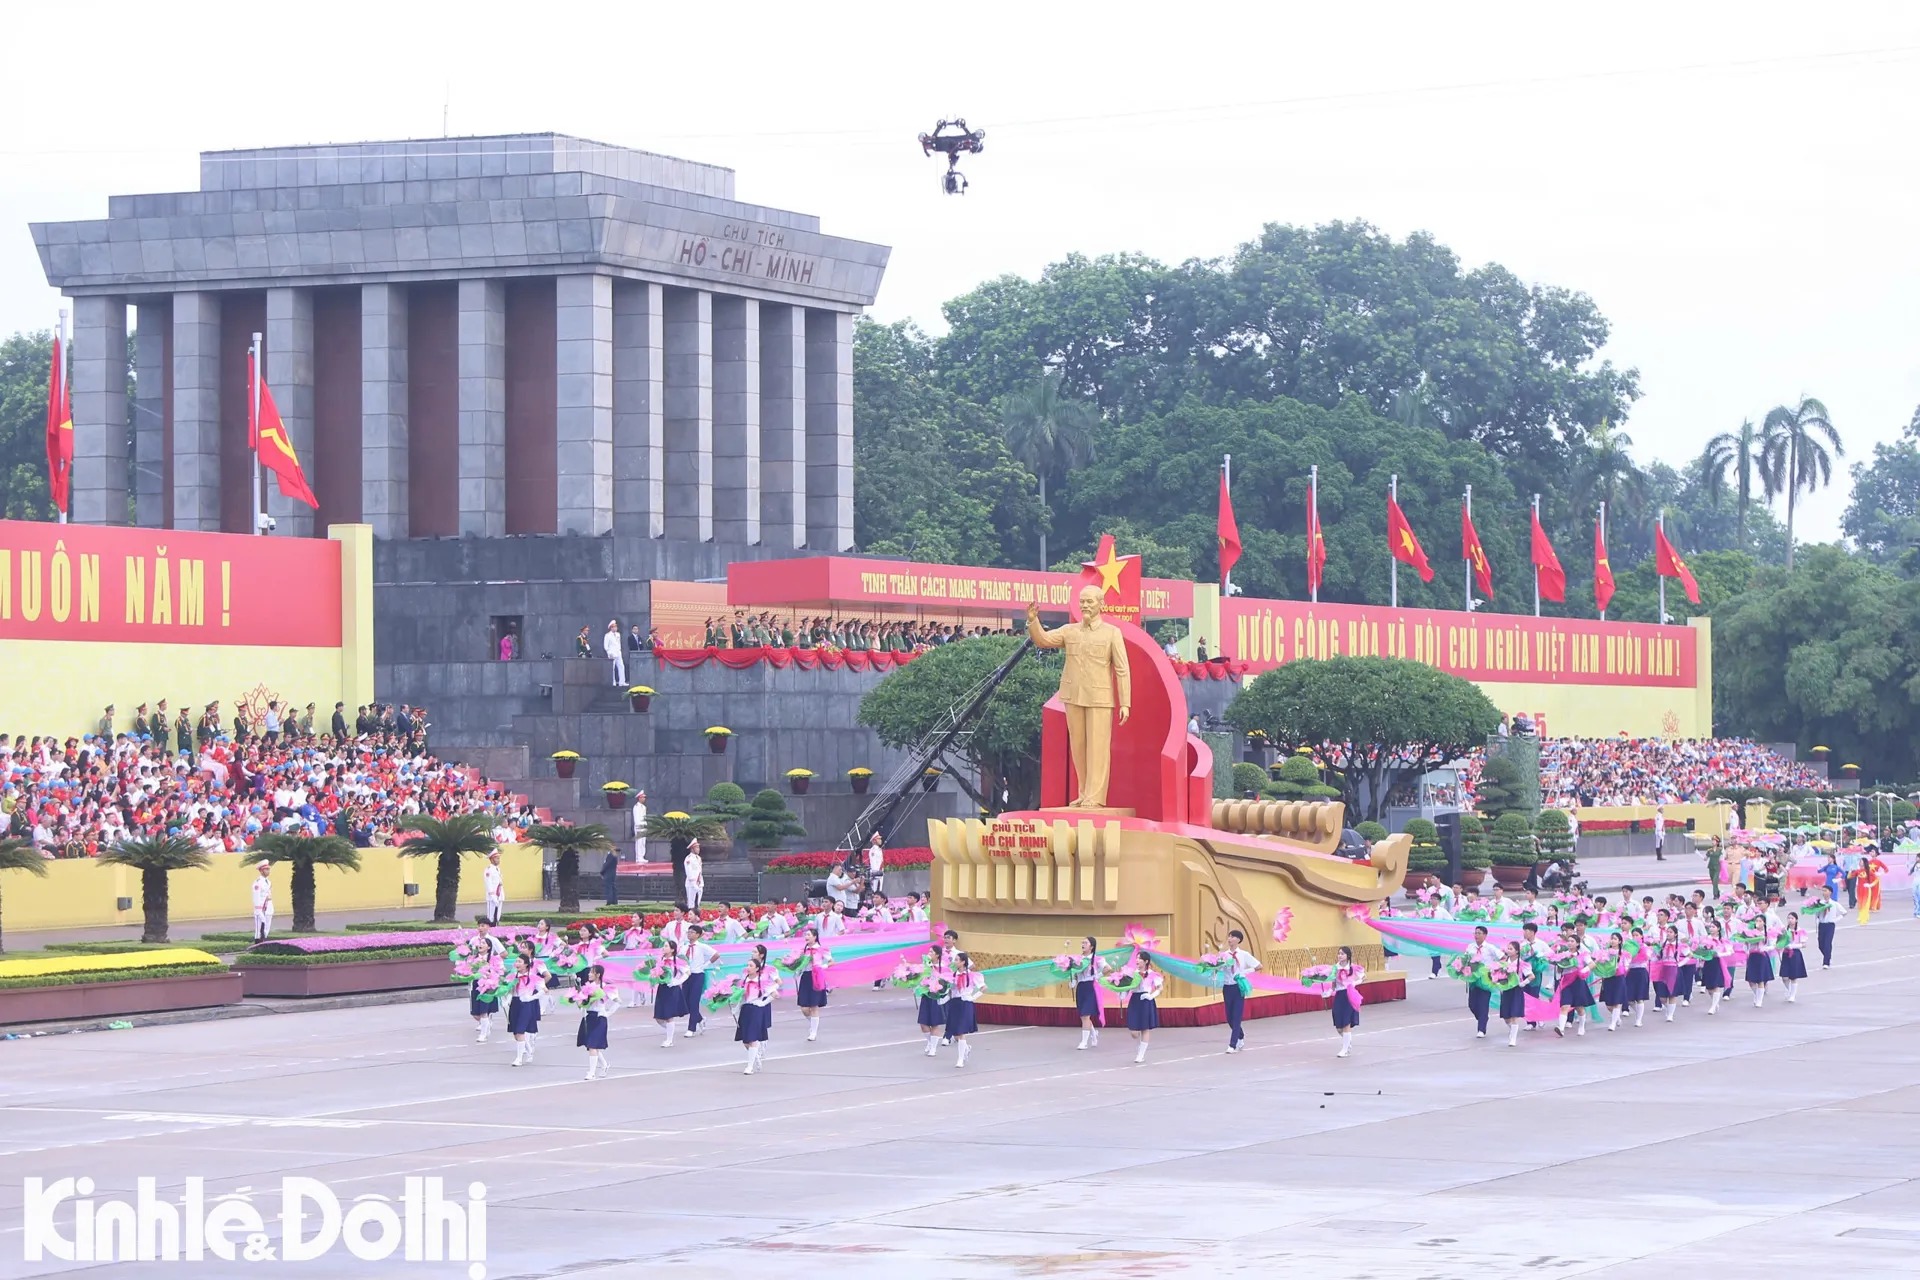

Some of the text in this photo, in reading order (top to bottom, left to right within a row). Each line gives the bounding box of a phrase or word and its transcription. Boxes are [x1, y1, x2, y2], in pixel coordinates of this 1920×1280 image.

[861, 572, 887, 594] TINH
[920, 572, 946, 598] CÁCH
[949, 577, 977, 602] MẠNG
[979, 578, 1012, 601] THÁNG
[1014, 578, 1034, 602] TÁM
[1036, 580, 1048, 604] VÀ
[1238, 608, 1285, 662] NƯỚC
[1449, 618, 1478, 670] CHỦ
[1486, 624, 1530, 671] NGHĨA
[1536, 624, 1566, 680] VIỆT
[1572, 633, 1599, 674] NAM
[1606, 630, 1642, 675] MUÔN
[992, 820, 1035, 834] CHỦ TỊCH
[982, 832, 1047, 847] HỒ CHÍ MINH
